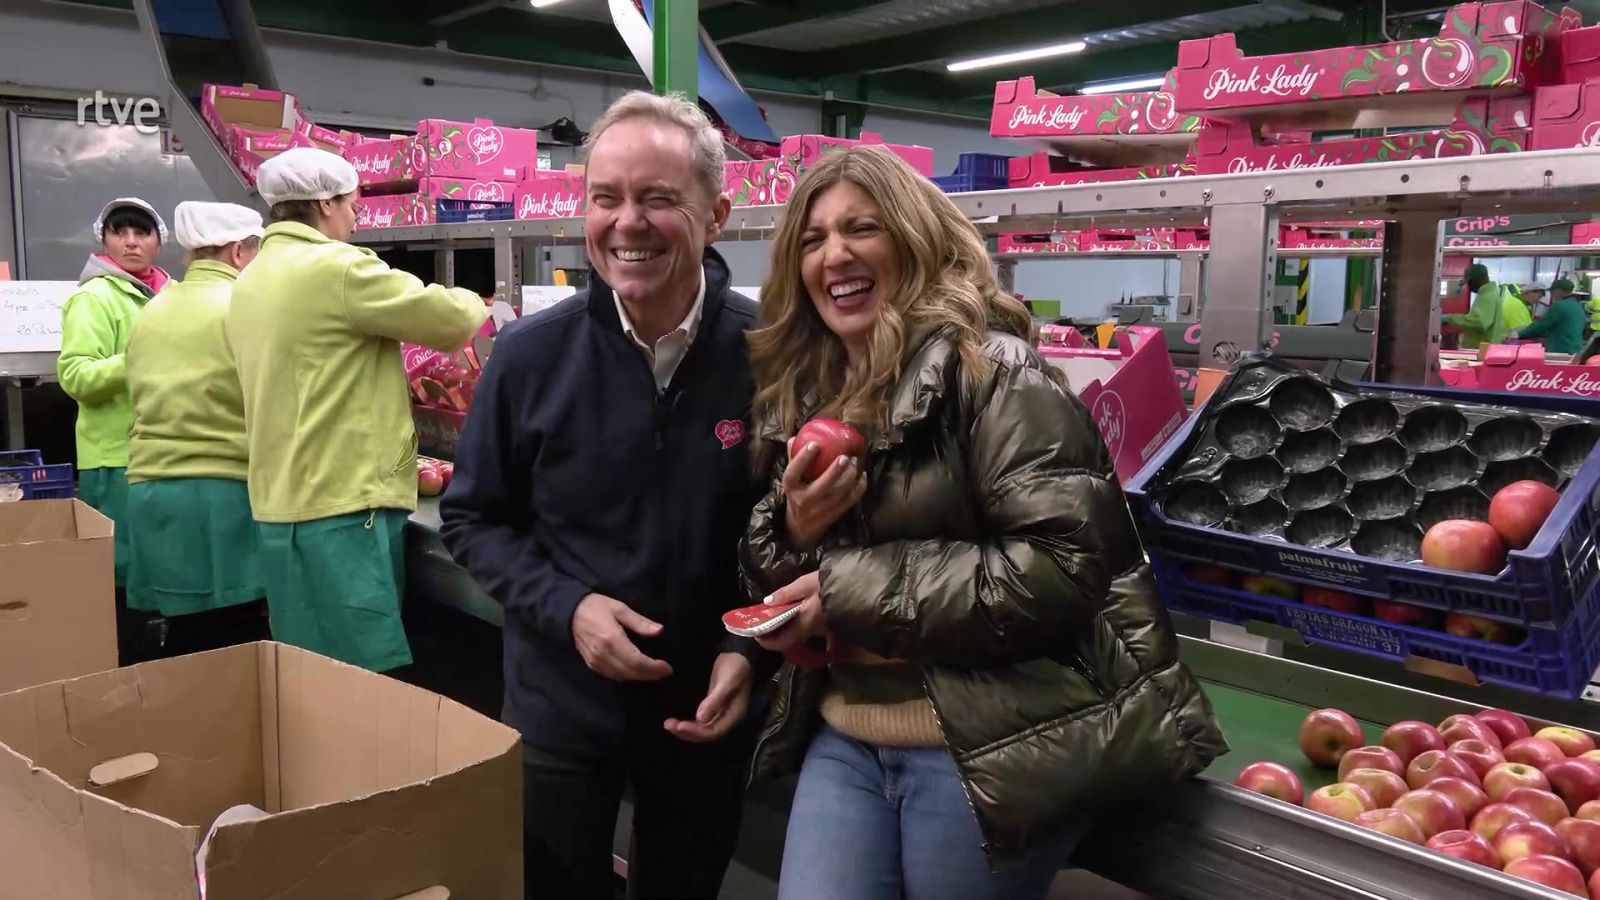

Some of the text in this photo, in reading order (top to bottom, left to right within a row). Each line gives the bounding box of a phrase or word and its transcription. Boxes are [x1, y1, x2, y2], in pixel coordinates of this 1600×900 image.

[1203, 64, 1319, 100] Pink Lady
[1008, 104, 1083, 130] Pink Lady
[473, 130, 497, 147] Pink
[477, 141, 499, 155] Lady
[370, 153, 390, 175] Lady
[518, 192, 578, 219] Pink Lady
[1455, 214, 1511, 233] Crip's
[1505, 369, 1600, 397] Pink La
[1278, 551, 1361, 574] palmafruit
[1381, 640, 1401, 655] 97
